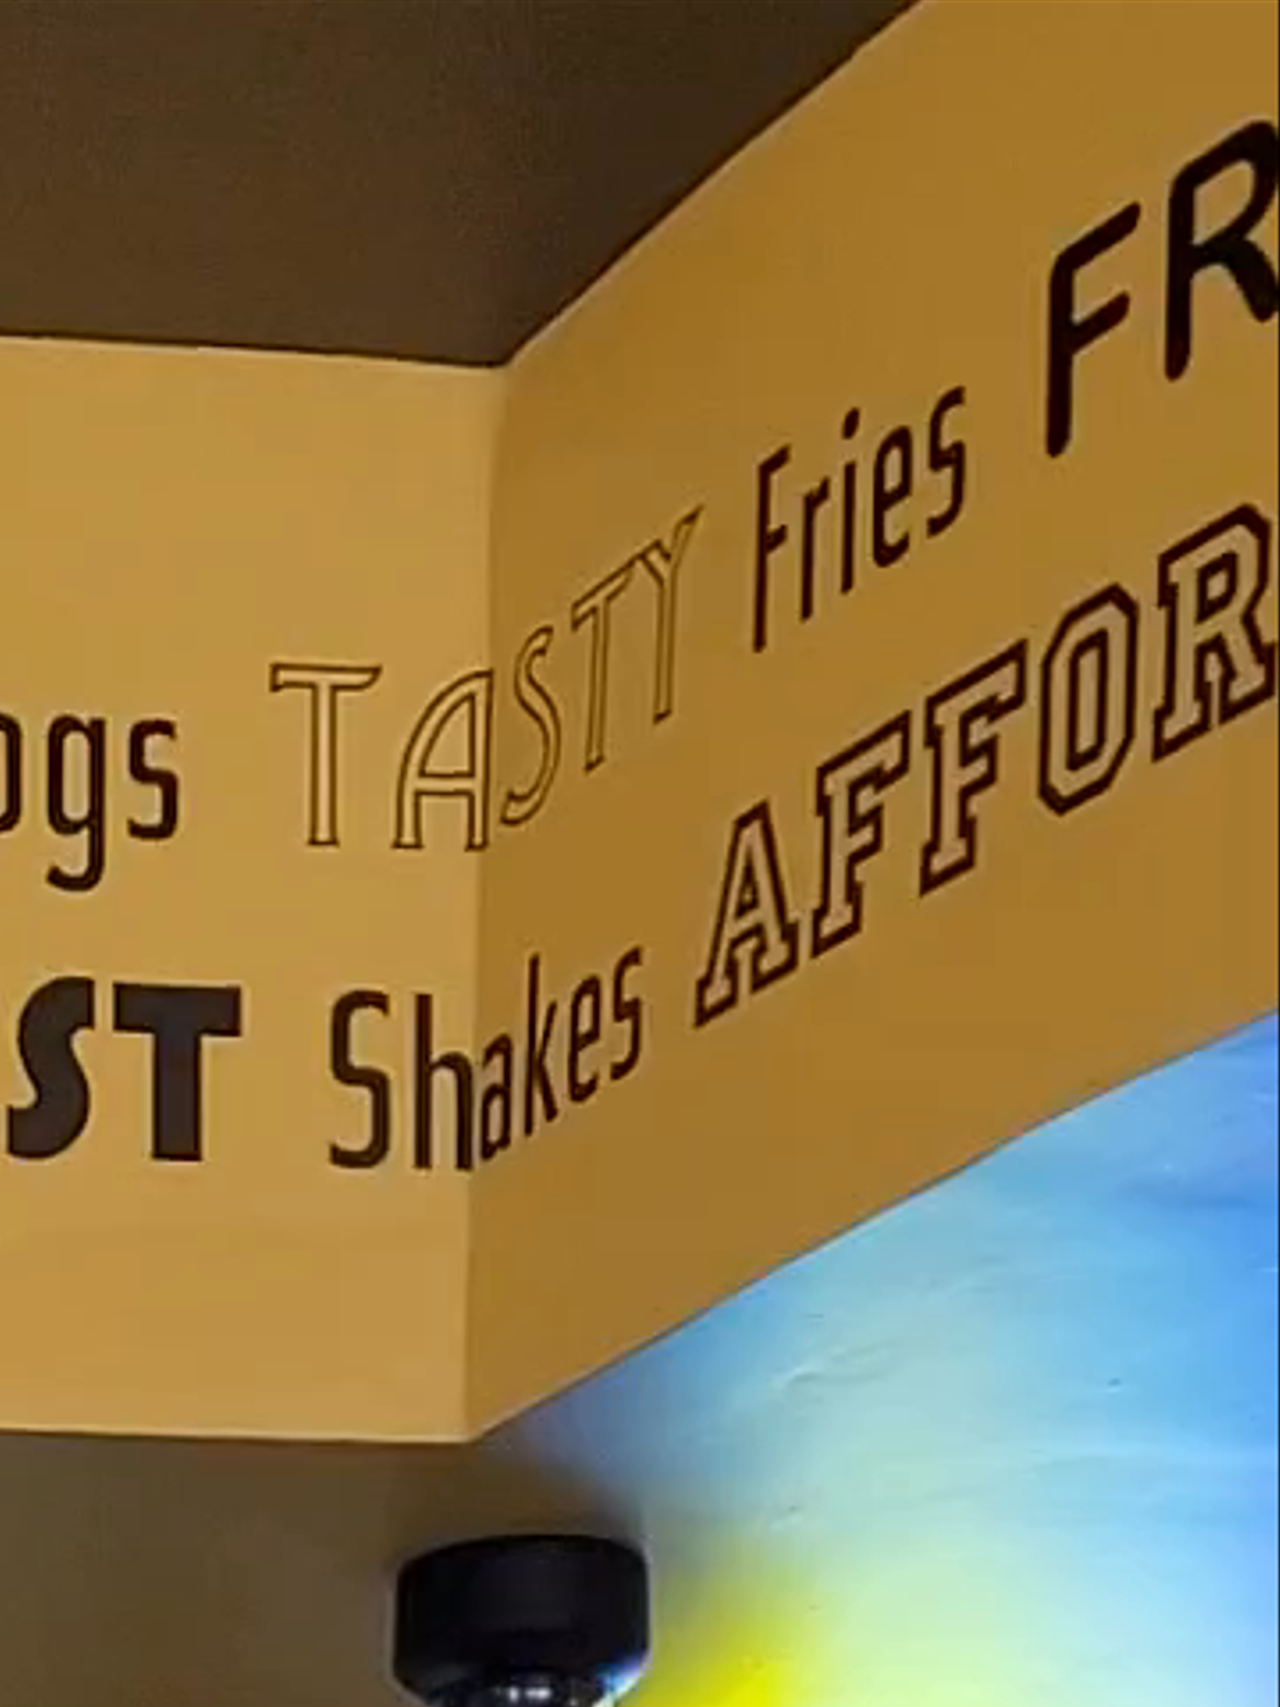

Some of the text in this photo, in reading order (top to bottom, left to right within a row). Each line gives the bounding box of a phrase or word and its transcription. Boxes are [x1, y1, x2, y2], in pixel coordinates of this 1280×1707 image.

[269, 504, 704, 851] TASTY
[751, 385, 967, 654] Fries
[1044, 118, 1280, 459] FR
[328, 944, 646, 1173] Shakes
[691, 501, 1280, 1030] AFFOR
